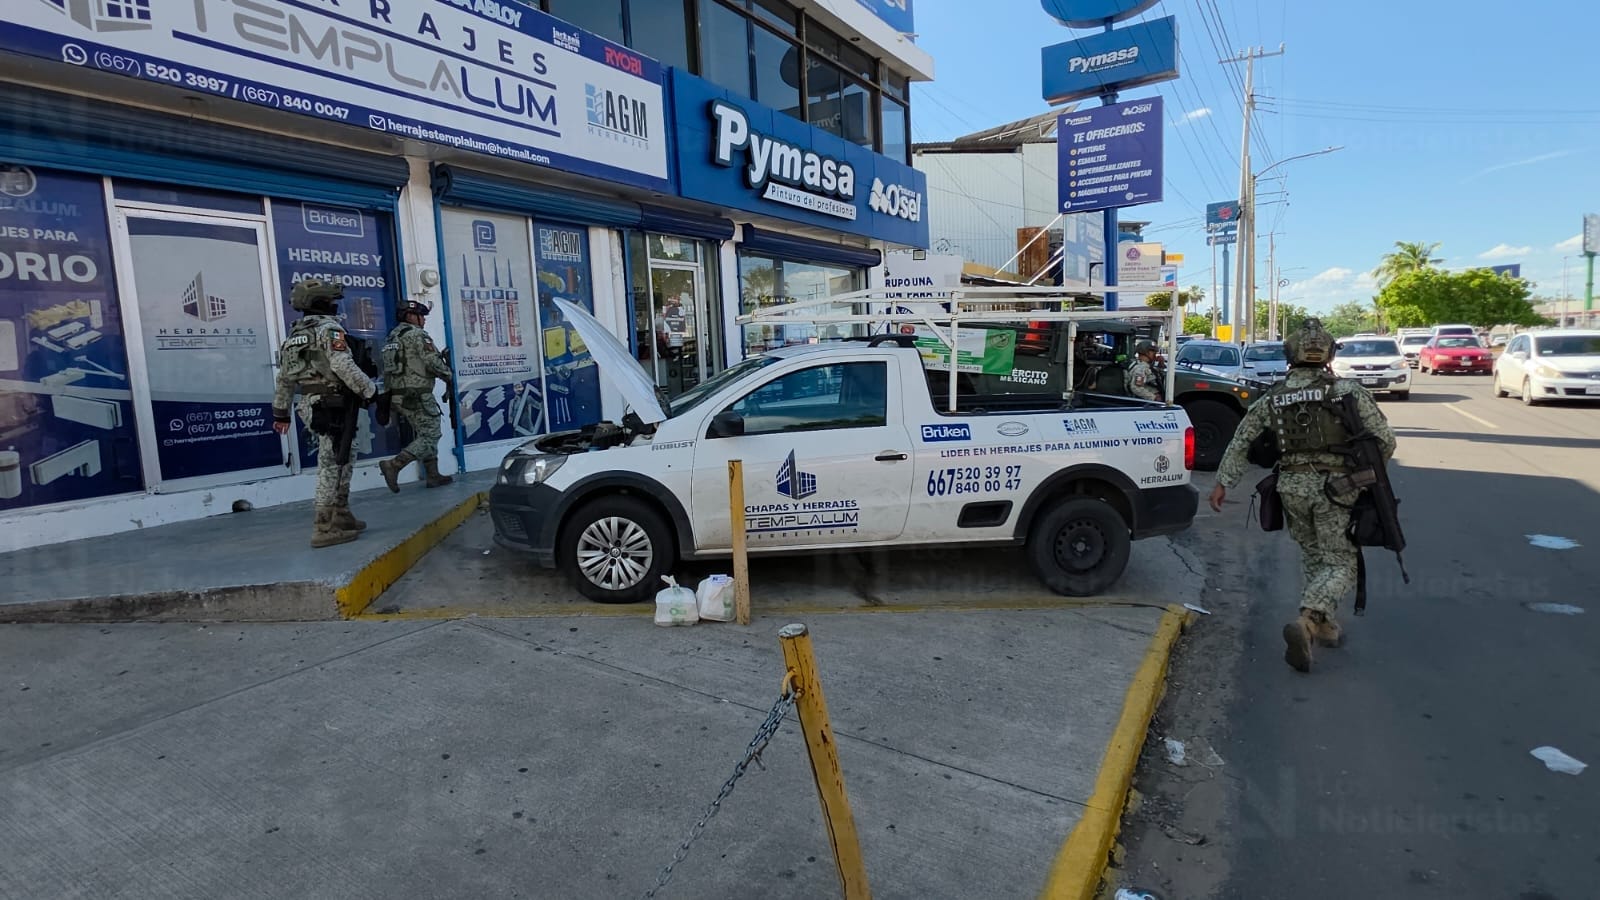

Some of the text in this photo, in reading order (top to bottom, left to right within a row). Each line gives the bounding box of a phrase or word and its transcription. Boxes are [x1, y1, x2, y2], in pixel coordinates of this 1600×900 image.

[474, 0, 523, 28] ABLOY
[323, 0, 549, 75] RAJES
[604, 46, 642, 76] RYOBI
[1069, 46, 1139, 73] Pymasa
[94, 51, 142, 77] (667)
[146, 62, 182, 83] 520
[186, 71, 229, 94] 3997
[242, 87, 280, 108] (667)
[283, 94, 312, 112] 840
[314, 102, 350, 120] 0047
[606, 90, 648, 138] AGM
[388, 118, 551, 165] herrajestemplalum@hotmail.com
[1073, 122, 1146, 144] TE OFRECEMOS:
[714, 104, 855, 197] Pymasa
[1077, 154, 1108, 166] ESMALTES
[771, 184, 856, 218] Pintura del profesional
[886, 183, 922, 222] Osel
[309, 209, 358, 228] Brüken
[33, 228, 79, 242] PARA
[553, 230, 581, 255] AGM
[288, 248, 383, 267] HERRAJES Y
[885, 276, 934, 288] RUPO UNA
[1000, 375, 1048, 386] MEXICANO
[1011, 367, 1049, 380] ÉRCITO
[186, 408, 263, 423] (667) 520 3997
[1073, 418, 1098, 431] AGM
[188, 419, 265, 436] (667) 840 0047
[922, 426, 969, 439] Brüken
[1134, 420, 1179, 432] jackson
[651, 441, 695, 451] ROBUST
[941, 436, 1163, 458] LIDER EN HERRAJES PARA ALUMINIO Y VIDRIO
[927, 465, 1022, 497] 667 520 39 97
[955, 479, 1021, 494] 840 00 47
[1141, 473, 1183, 484] HERRALUM
[745, 499, 857, 513] CHAPAS Y HERRAJES
[745, 512, 859, 529] TEMPLALUM
